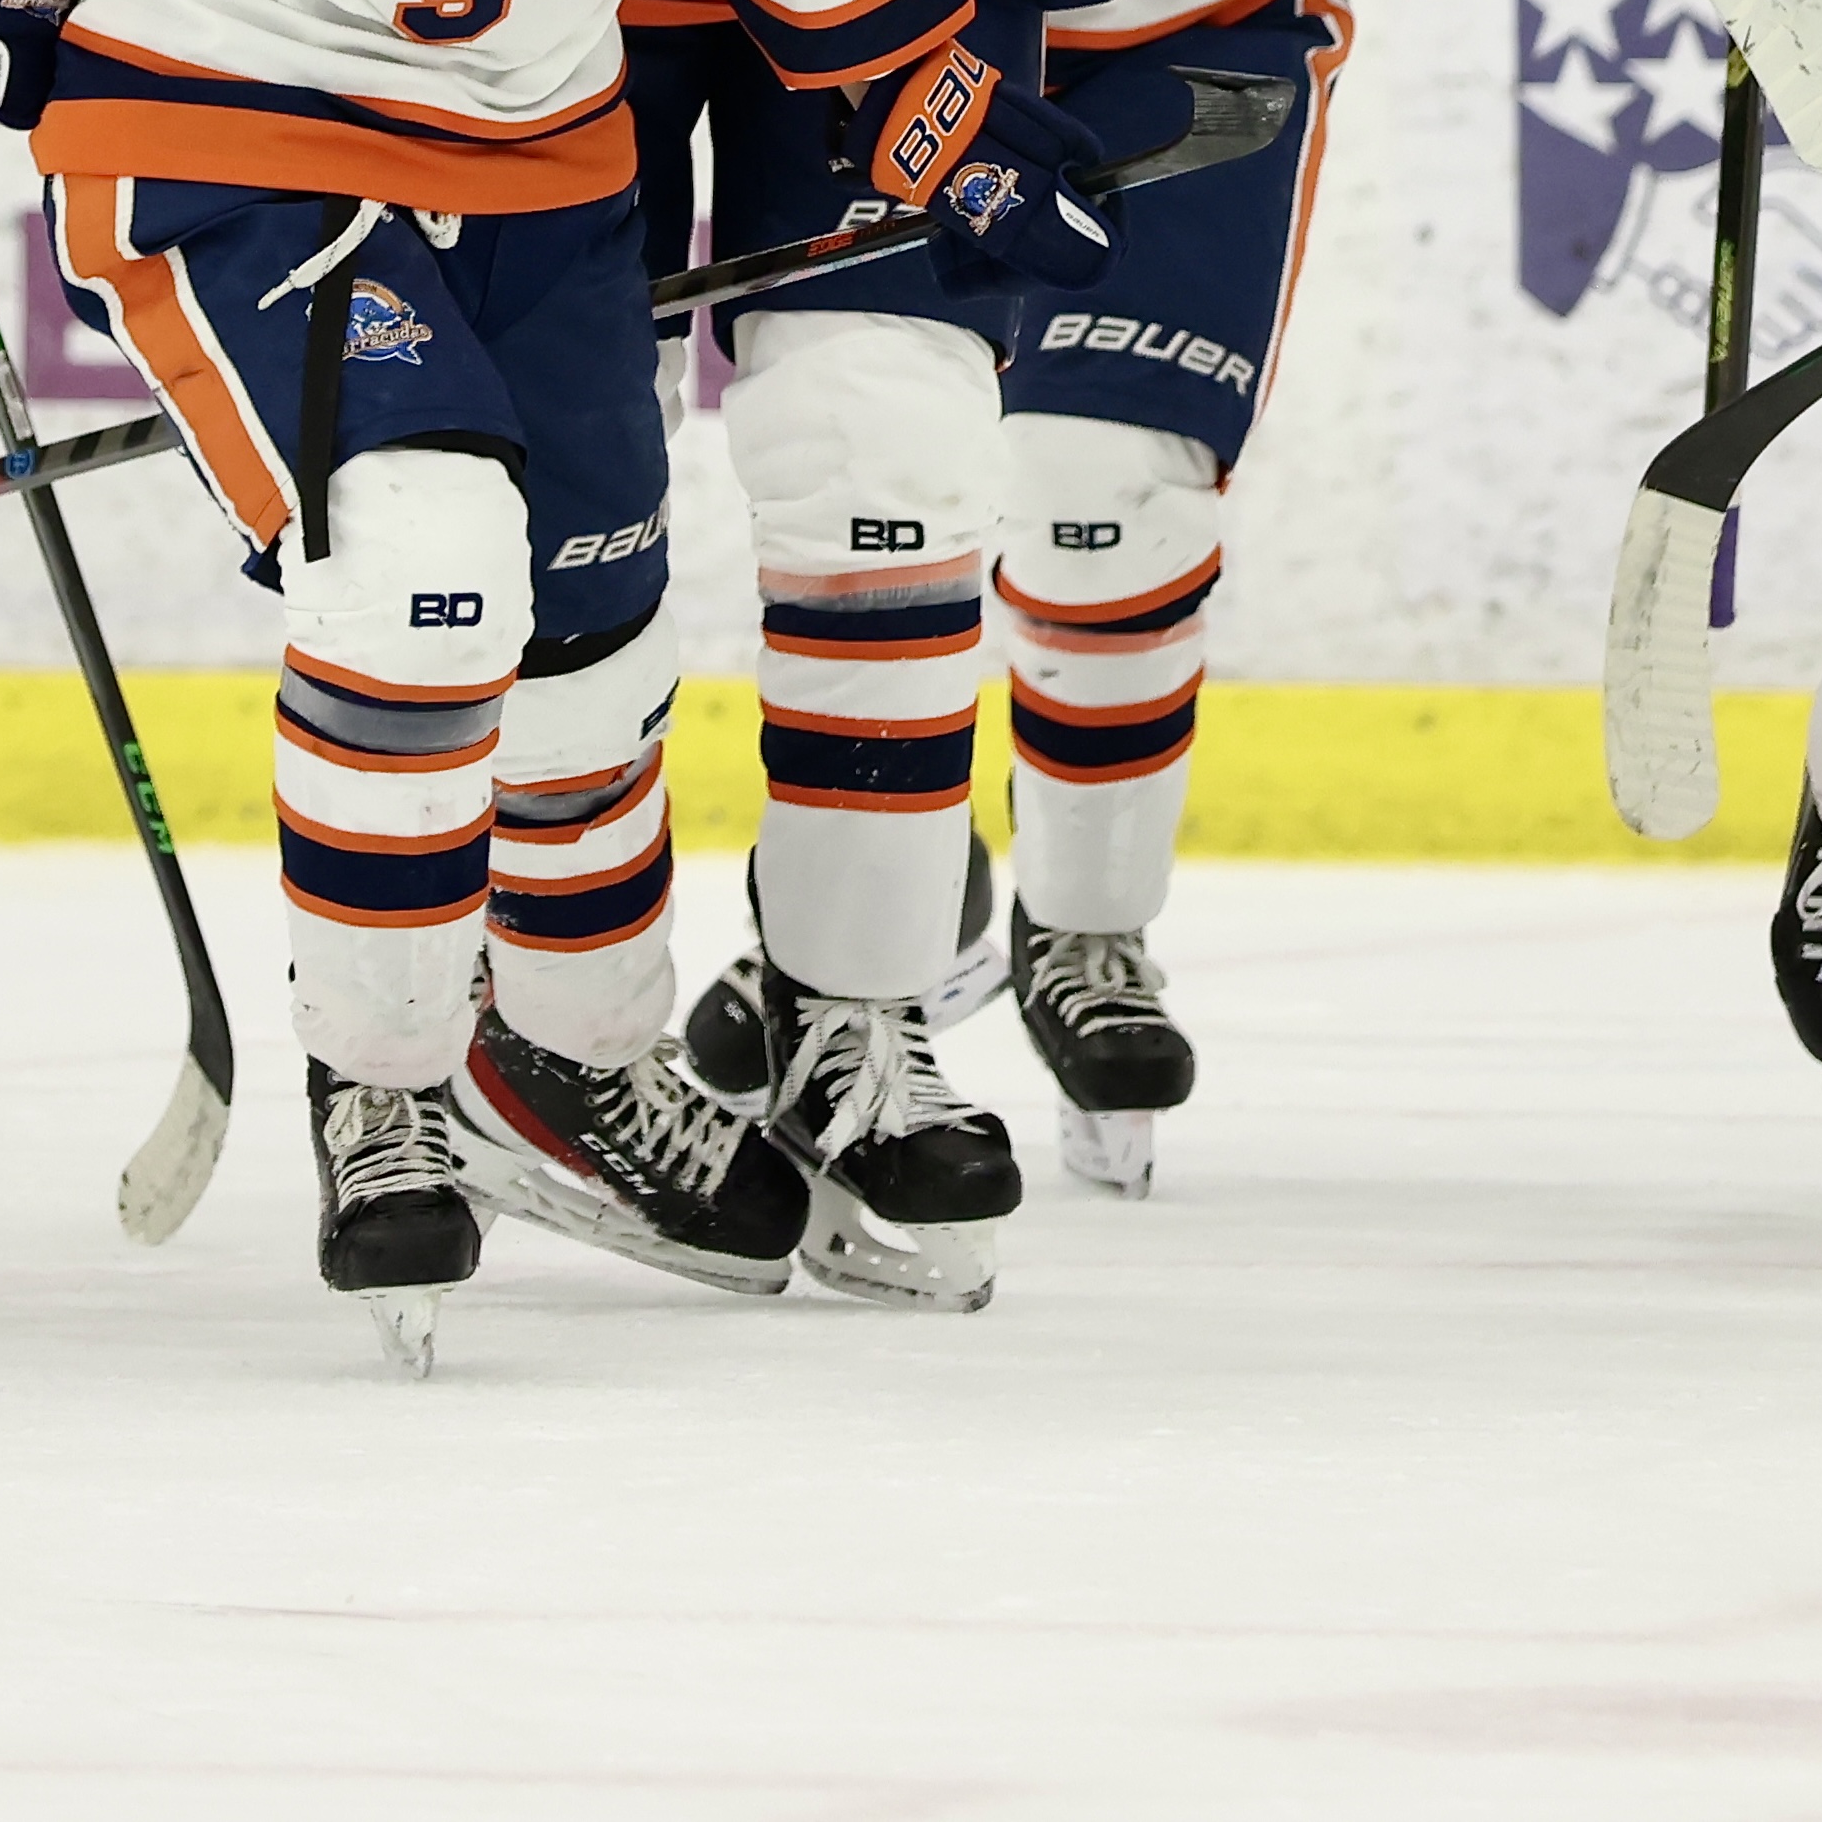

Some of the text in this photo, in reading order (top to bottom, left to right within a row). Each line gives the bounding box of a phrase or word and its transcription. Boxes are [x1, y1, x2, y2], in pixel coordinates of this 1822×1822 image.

[1040, 312, 1258, 398] BAUER
[547, 496, 671, 571] BAU
[850, 516, 926, 553] BD
[1051, 519, 1122, 551] BD
[409, 592, 484, 628] BD
[578, 1132, 659, 1195] CCM
